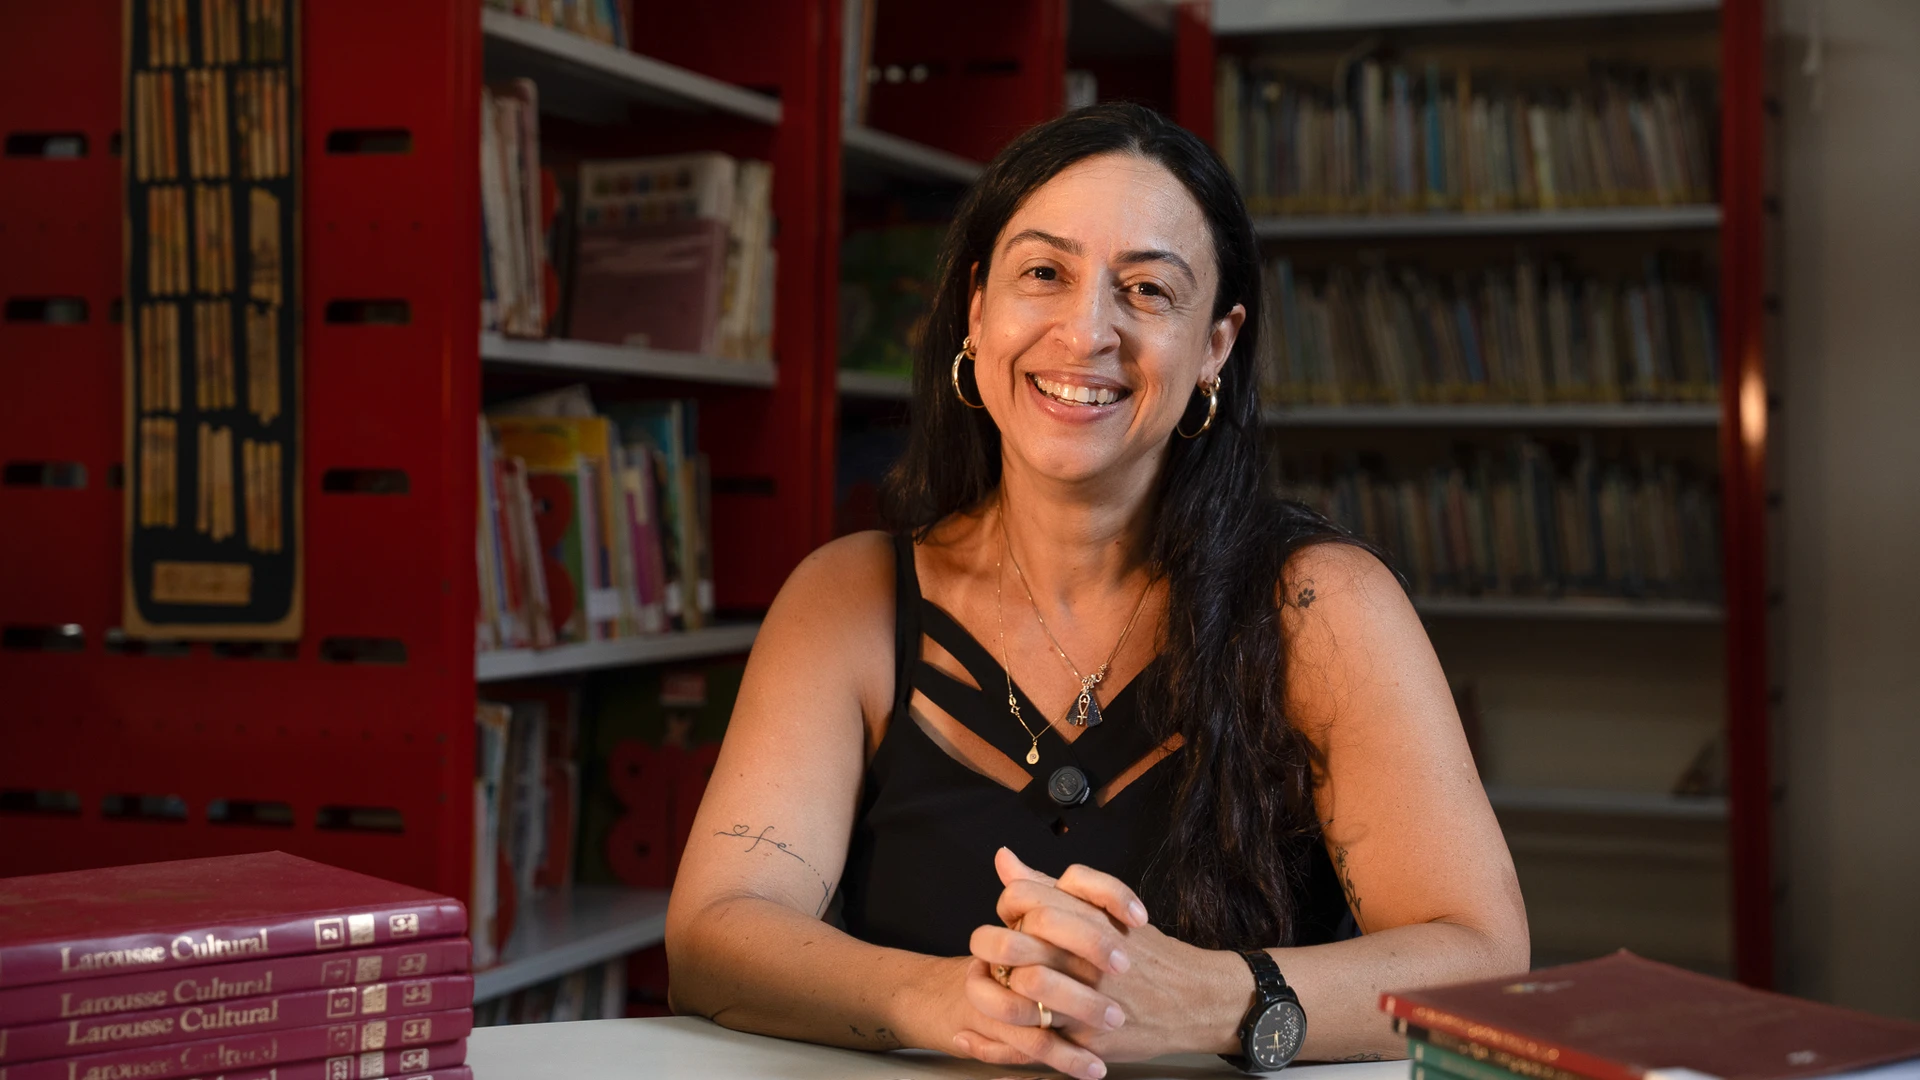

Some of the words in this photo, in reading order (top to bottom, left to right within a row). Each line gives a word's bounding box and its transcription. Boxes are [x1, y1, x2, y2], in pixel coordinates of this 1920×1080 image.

[61, 945, 166, 972] Larousse
[171, 928, 269, 960] Cultural
[61, 990, 167, 1017] Larousse
[173, 971, 273, 1003] Cultural
[66, 1017, 174, 1045] Larousse
[179, 1000, 279, 1032] Cultural
